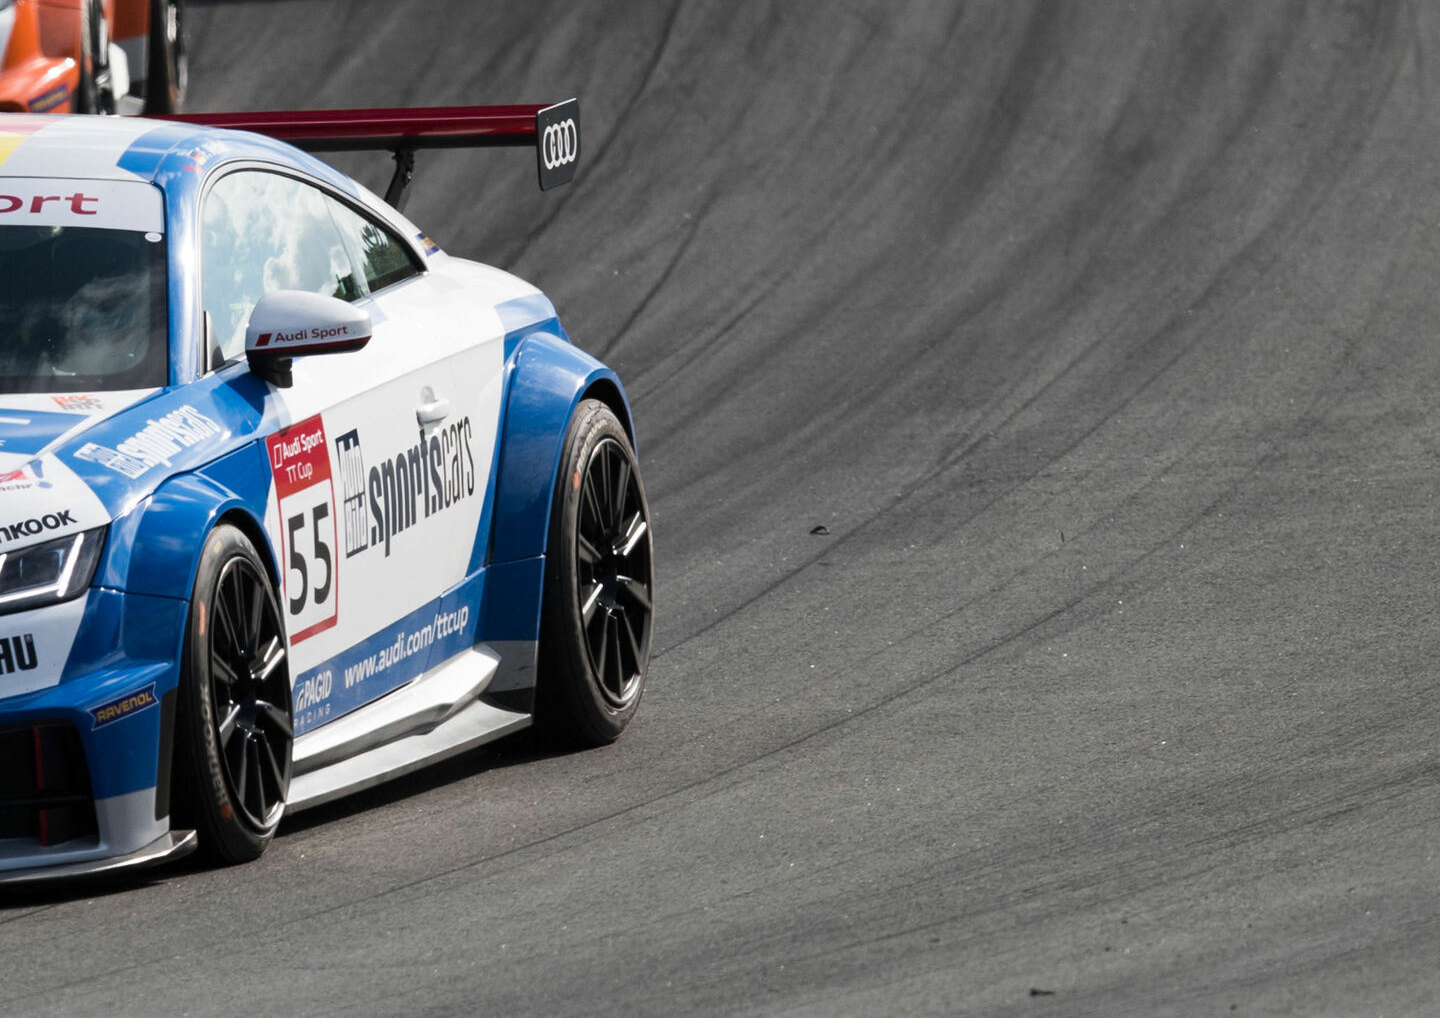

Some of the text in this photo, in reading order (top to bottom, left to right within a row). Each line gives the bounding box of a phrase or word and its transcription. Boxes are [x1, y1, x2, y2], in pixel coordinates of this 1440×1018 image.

[275, 325, 348, 343] Audi Sport
[282, 429, 324, 460] Audi Sport
[285, 463, 313, 484] TT Cup
[287, 501, 333, 617] 55
[344, 605, 469, 689] www.audi.com/ttcup
[303, 669, 333, 709] PAGID
[96, 691, 154, 722] RAVENOL
